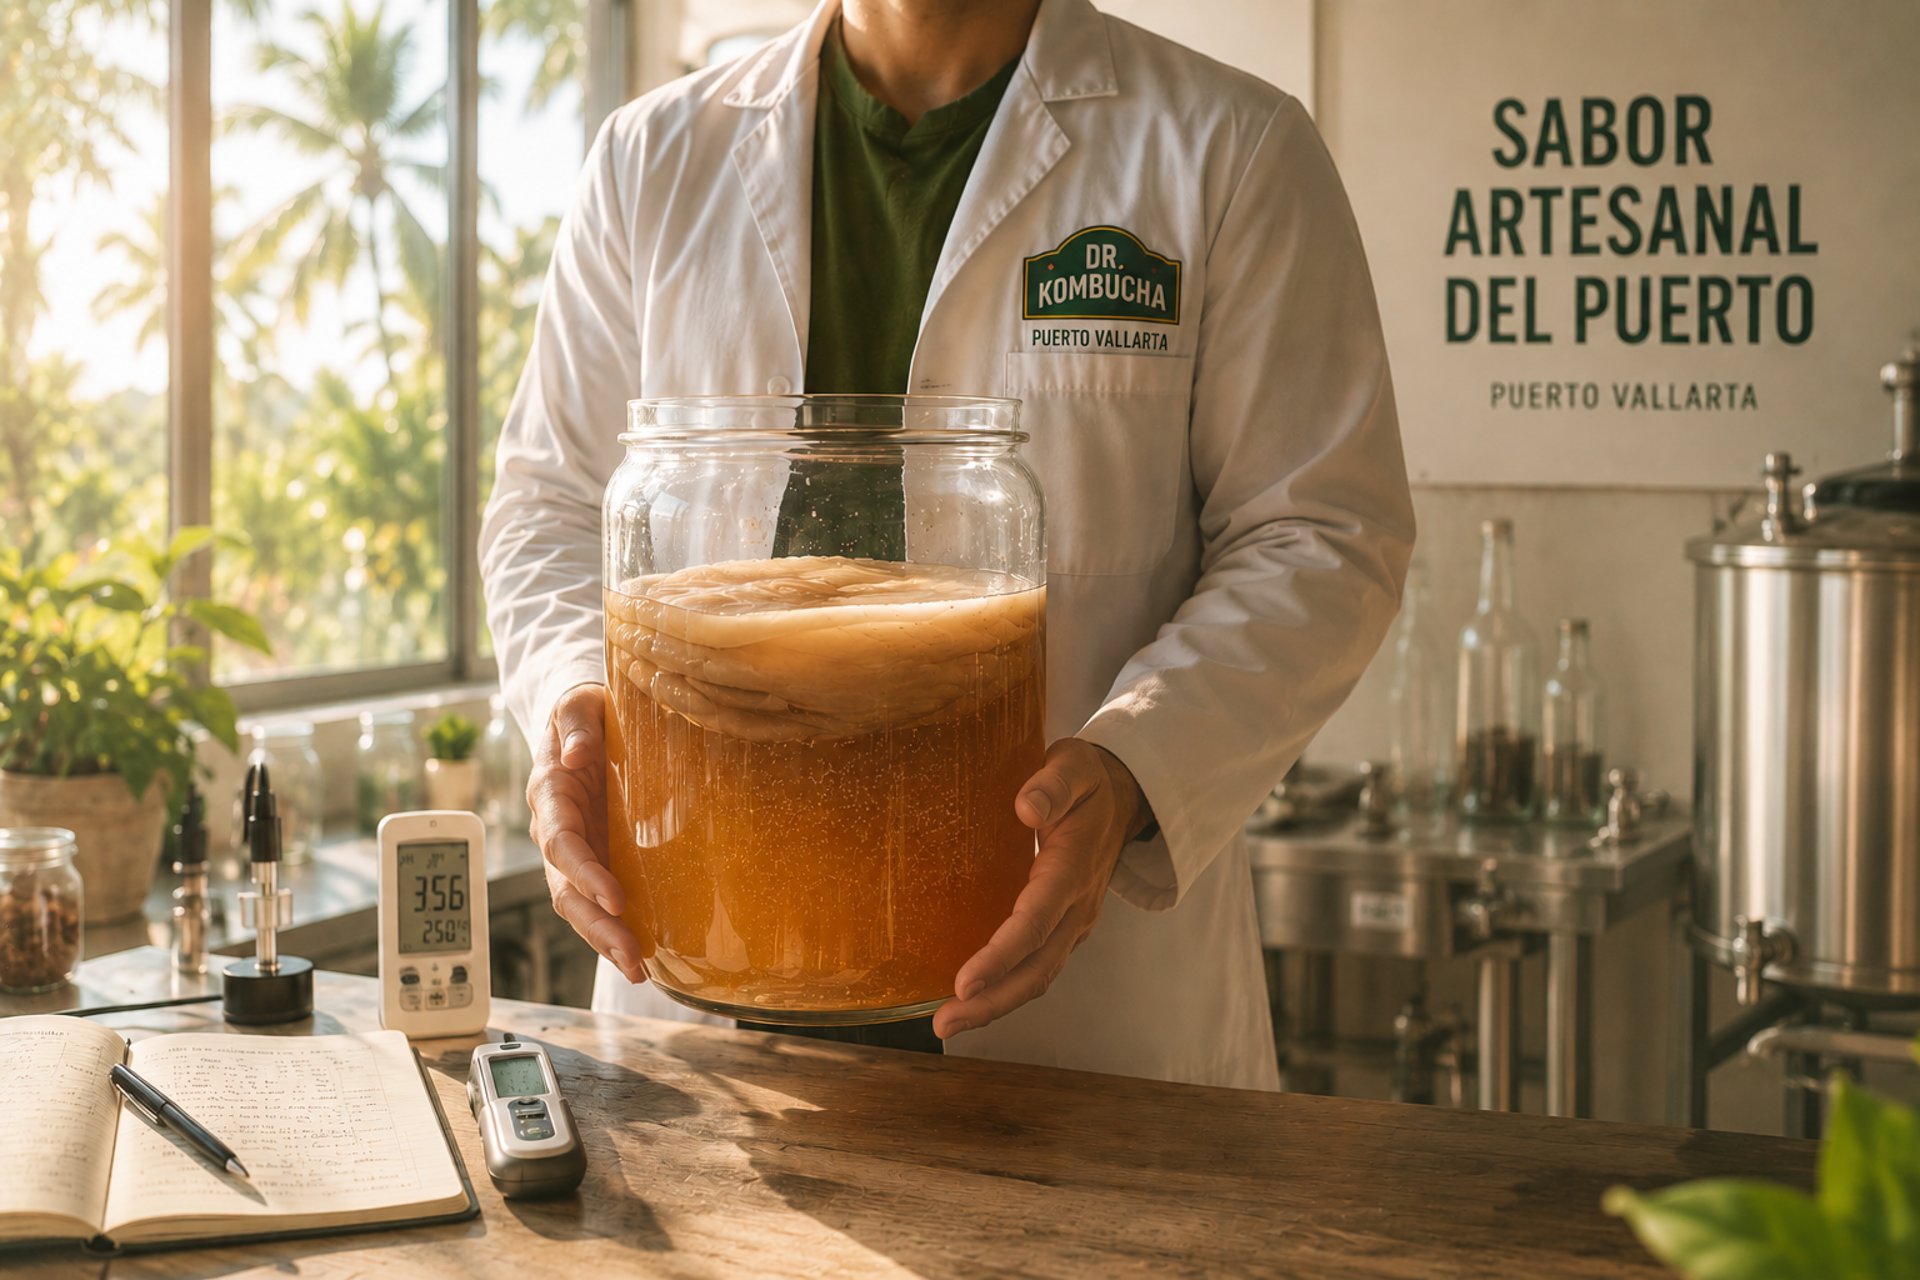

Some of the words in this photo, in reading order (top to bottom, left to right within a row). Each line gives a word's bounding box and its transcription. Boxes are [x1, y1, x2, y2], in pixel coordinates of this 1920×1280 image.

[1492, 94, 1714, 169] SABOR
[1444, 183, 1819, 257] ARTESANAL
[1085, 243, 1125, 270] DR.
[1038, 273, 1167, 312] KOMBUCHA
[1445, 275, 1553, 345] DEL
[1574, 274, 1815, 346] PUERTO
[1032, 329, 1090, 347] PUERTO
[1095, 330, 1169, 351] VALLARTA
[1490, 382, 1600, 410] PUERTO
[1612, 382, 1759, 411] VALLARTA
